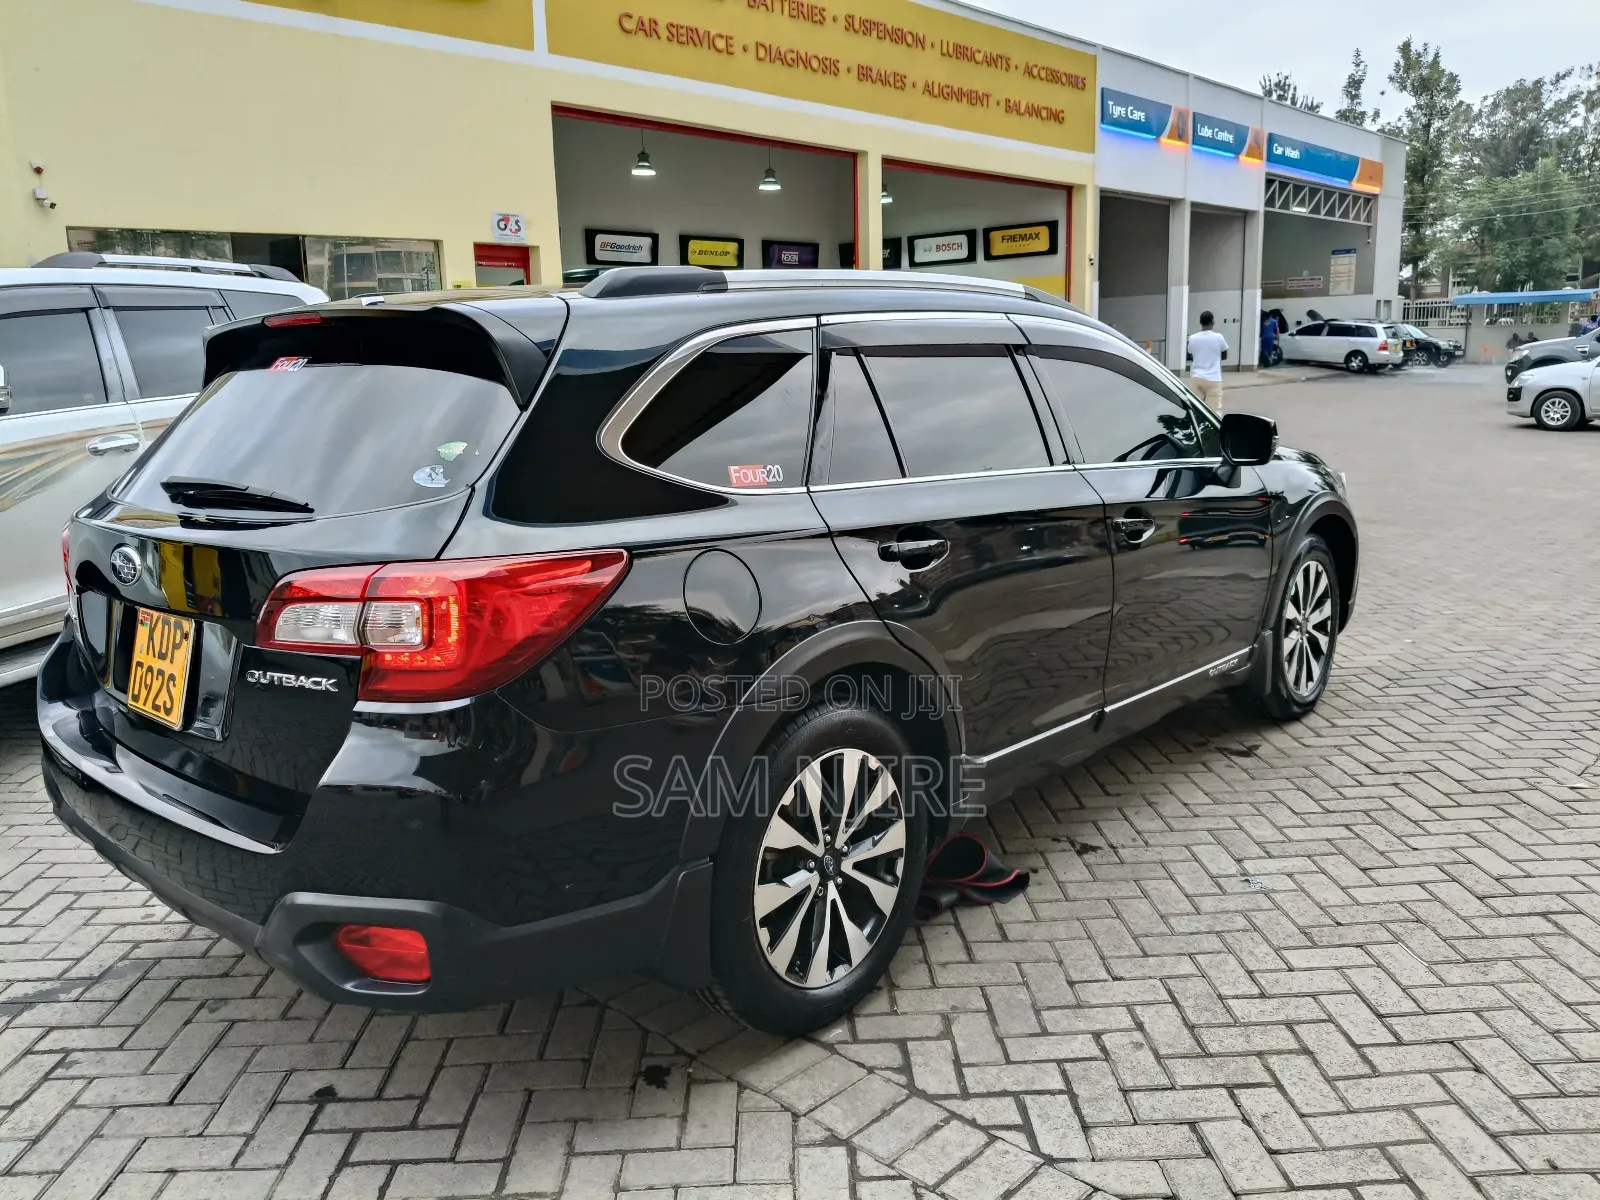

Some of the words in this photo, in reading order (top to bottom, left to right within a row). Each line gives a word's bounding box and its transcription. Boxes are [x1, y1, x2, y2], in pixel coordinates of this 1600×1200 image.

[844, 14, 926, 50] SUSPENSION
[940, 39, 1011, 72] LUBRICANTS
[1023, 62, 1086, 91] ACCESSORIES
[618, 12, 661, 40] CAR
[666, 21, 735, 55] SERVICE
[755, 41, 840, 76] DIAGNOSIS
[857, 63, 907, 91] BRAKES
[922, 79, 992, 109] ALIGNMENT
[1004, 97, 1065, 124] BALANCING
[1108, 101, 1126, 119] Tyre
[1127, 107, 1146, 122] Care
[1197, 123, 1213, 138] Lube
[1214, 127, 1234, 144] Centre
[1273, 143, 1284, 155] Car
[1285, 144, 1300, 159] Wash
[600, 241, 643, 252] BFGoodrich
[935, 242, 963, 253] BOSCH
[1001, 231, 1041, 244] FREMAX
[697, 249, 731, 257] DUNLOP
[146, 612, 185, 664] KDP
[131, 660, 177, 717] 092S
[245, 669, 339, 693] OUTBACK
